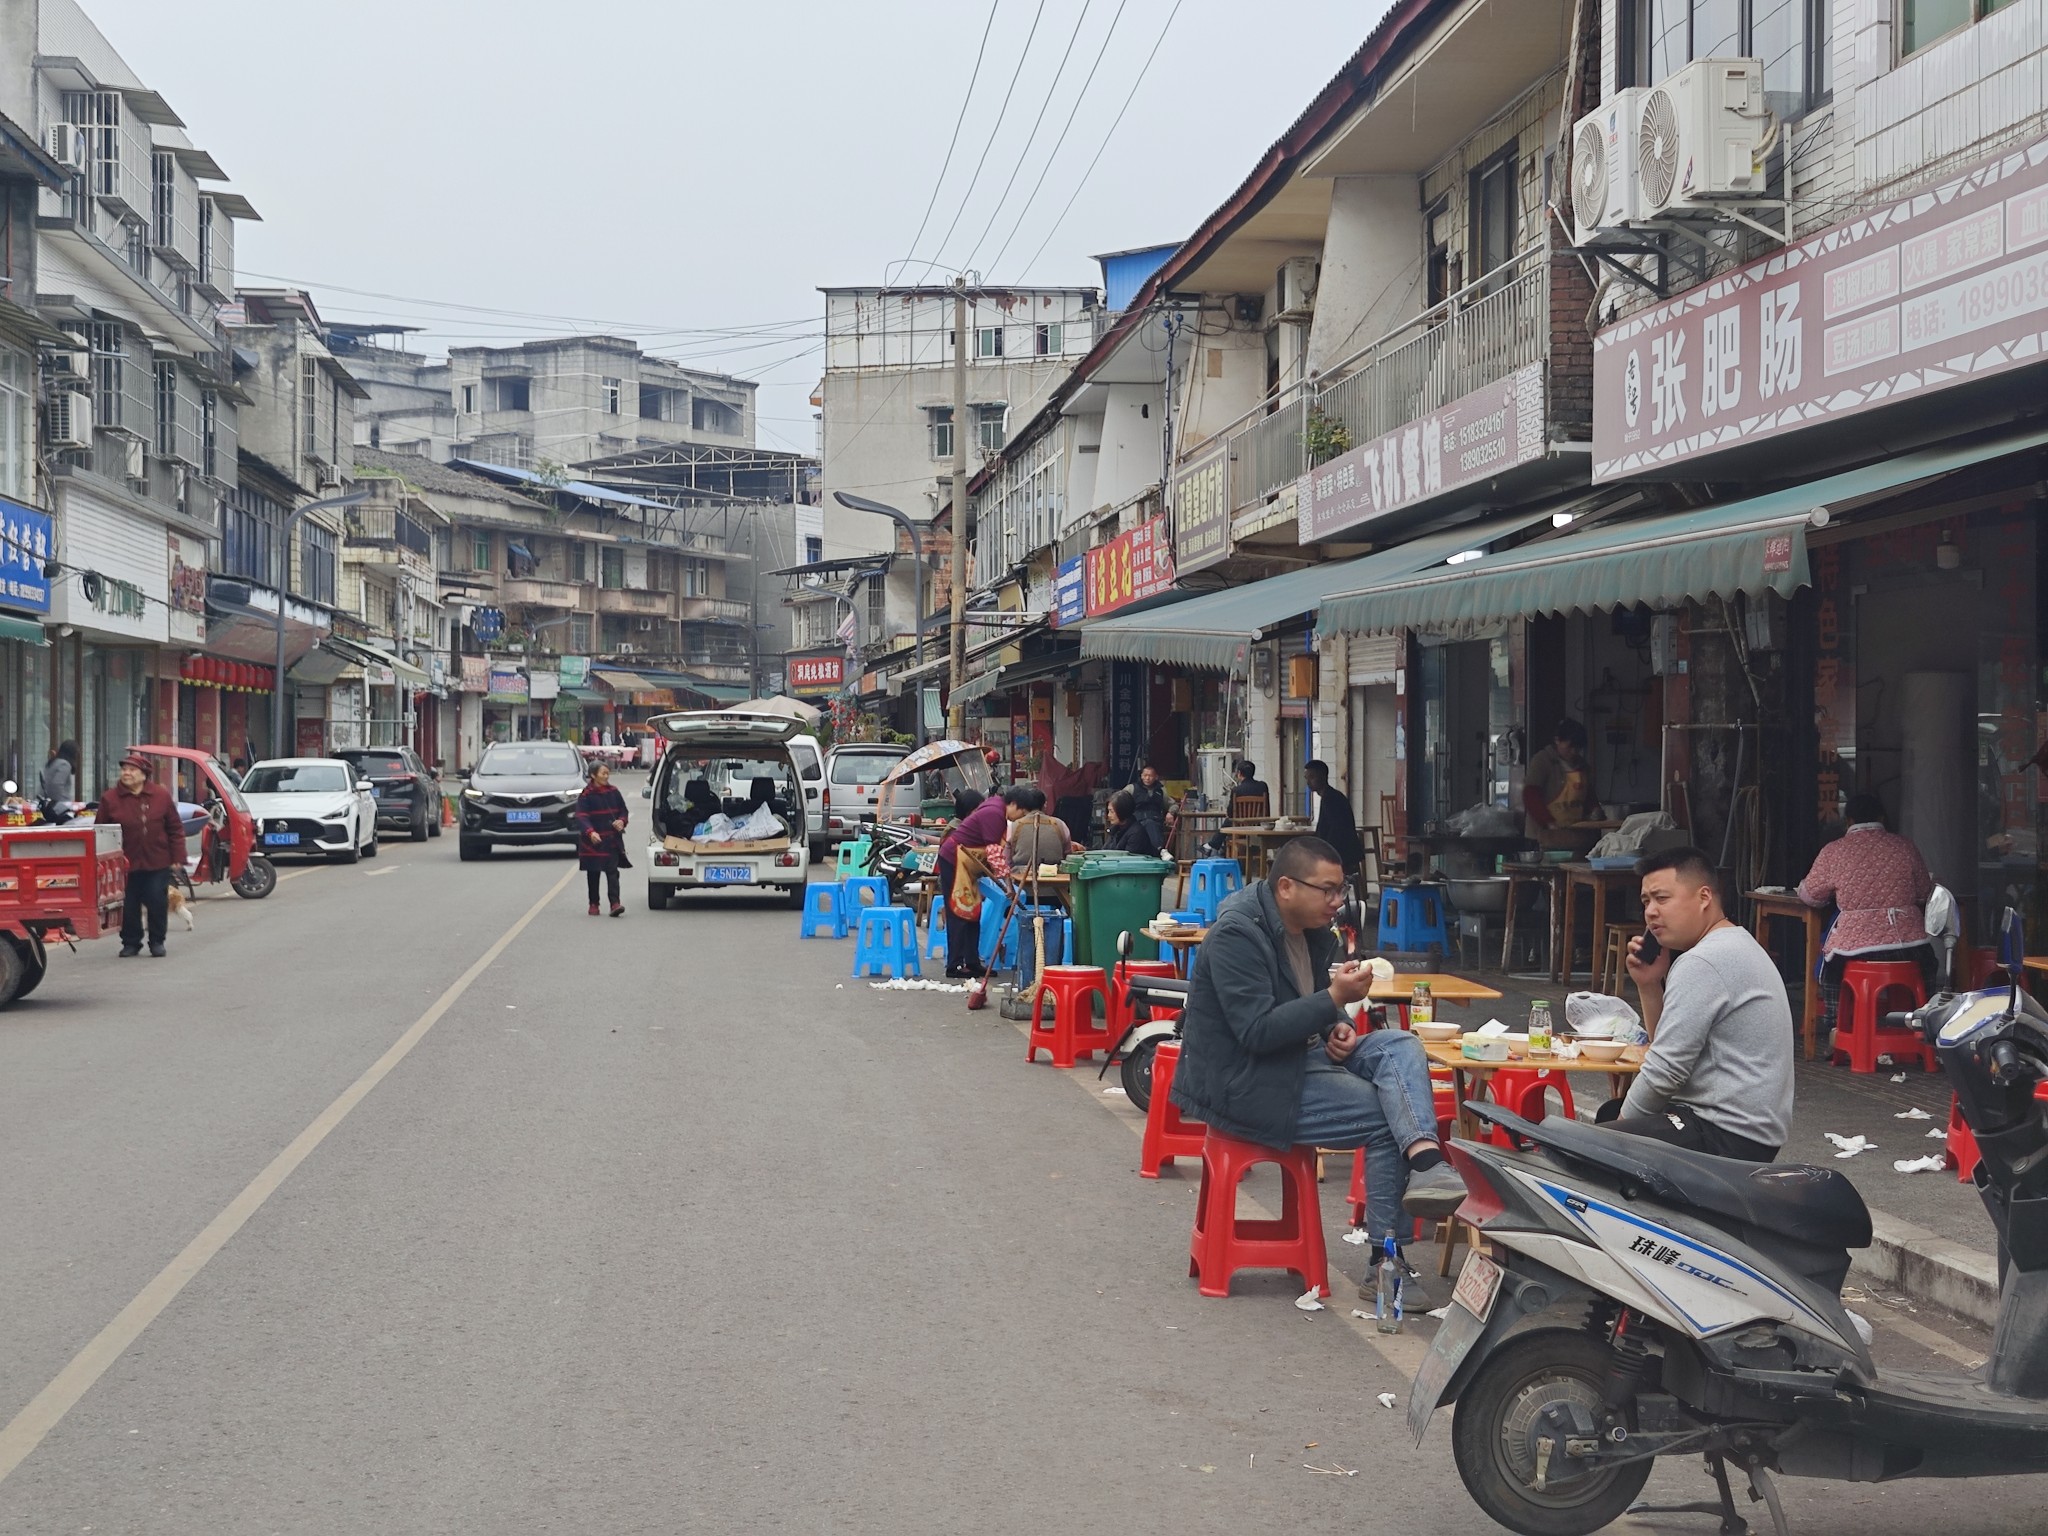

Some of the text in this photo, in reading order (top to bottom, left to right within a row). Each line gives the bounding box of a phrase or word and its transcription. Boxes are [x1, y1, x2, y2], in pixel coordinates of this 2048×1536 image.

[1832, 258, 1890, 308] 泡椒肥肠
[1651, 281, 1803, 436] 张肥肠
[1832, 317, 1890, 365] 豆汤肥肠
[1363, 416, 1442, 511] 飞机餐馆
[1628, 1235, 1682, 1266] 珠峰
